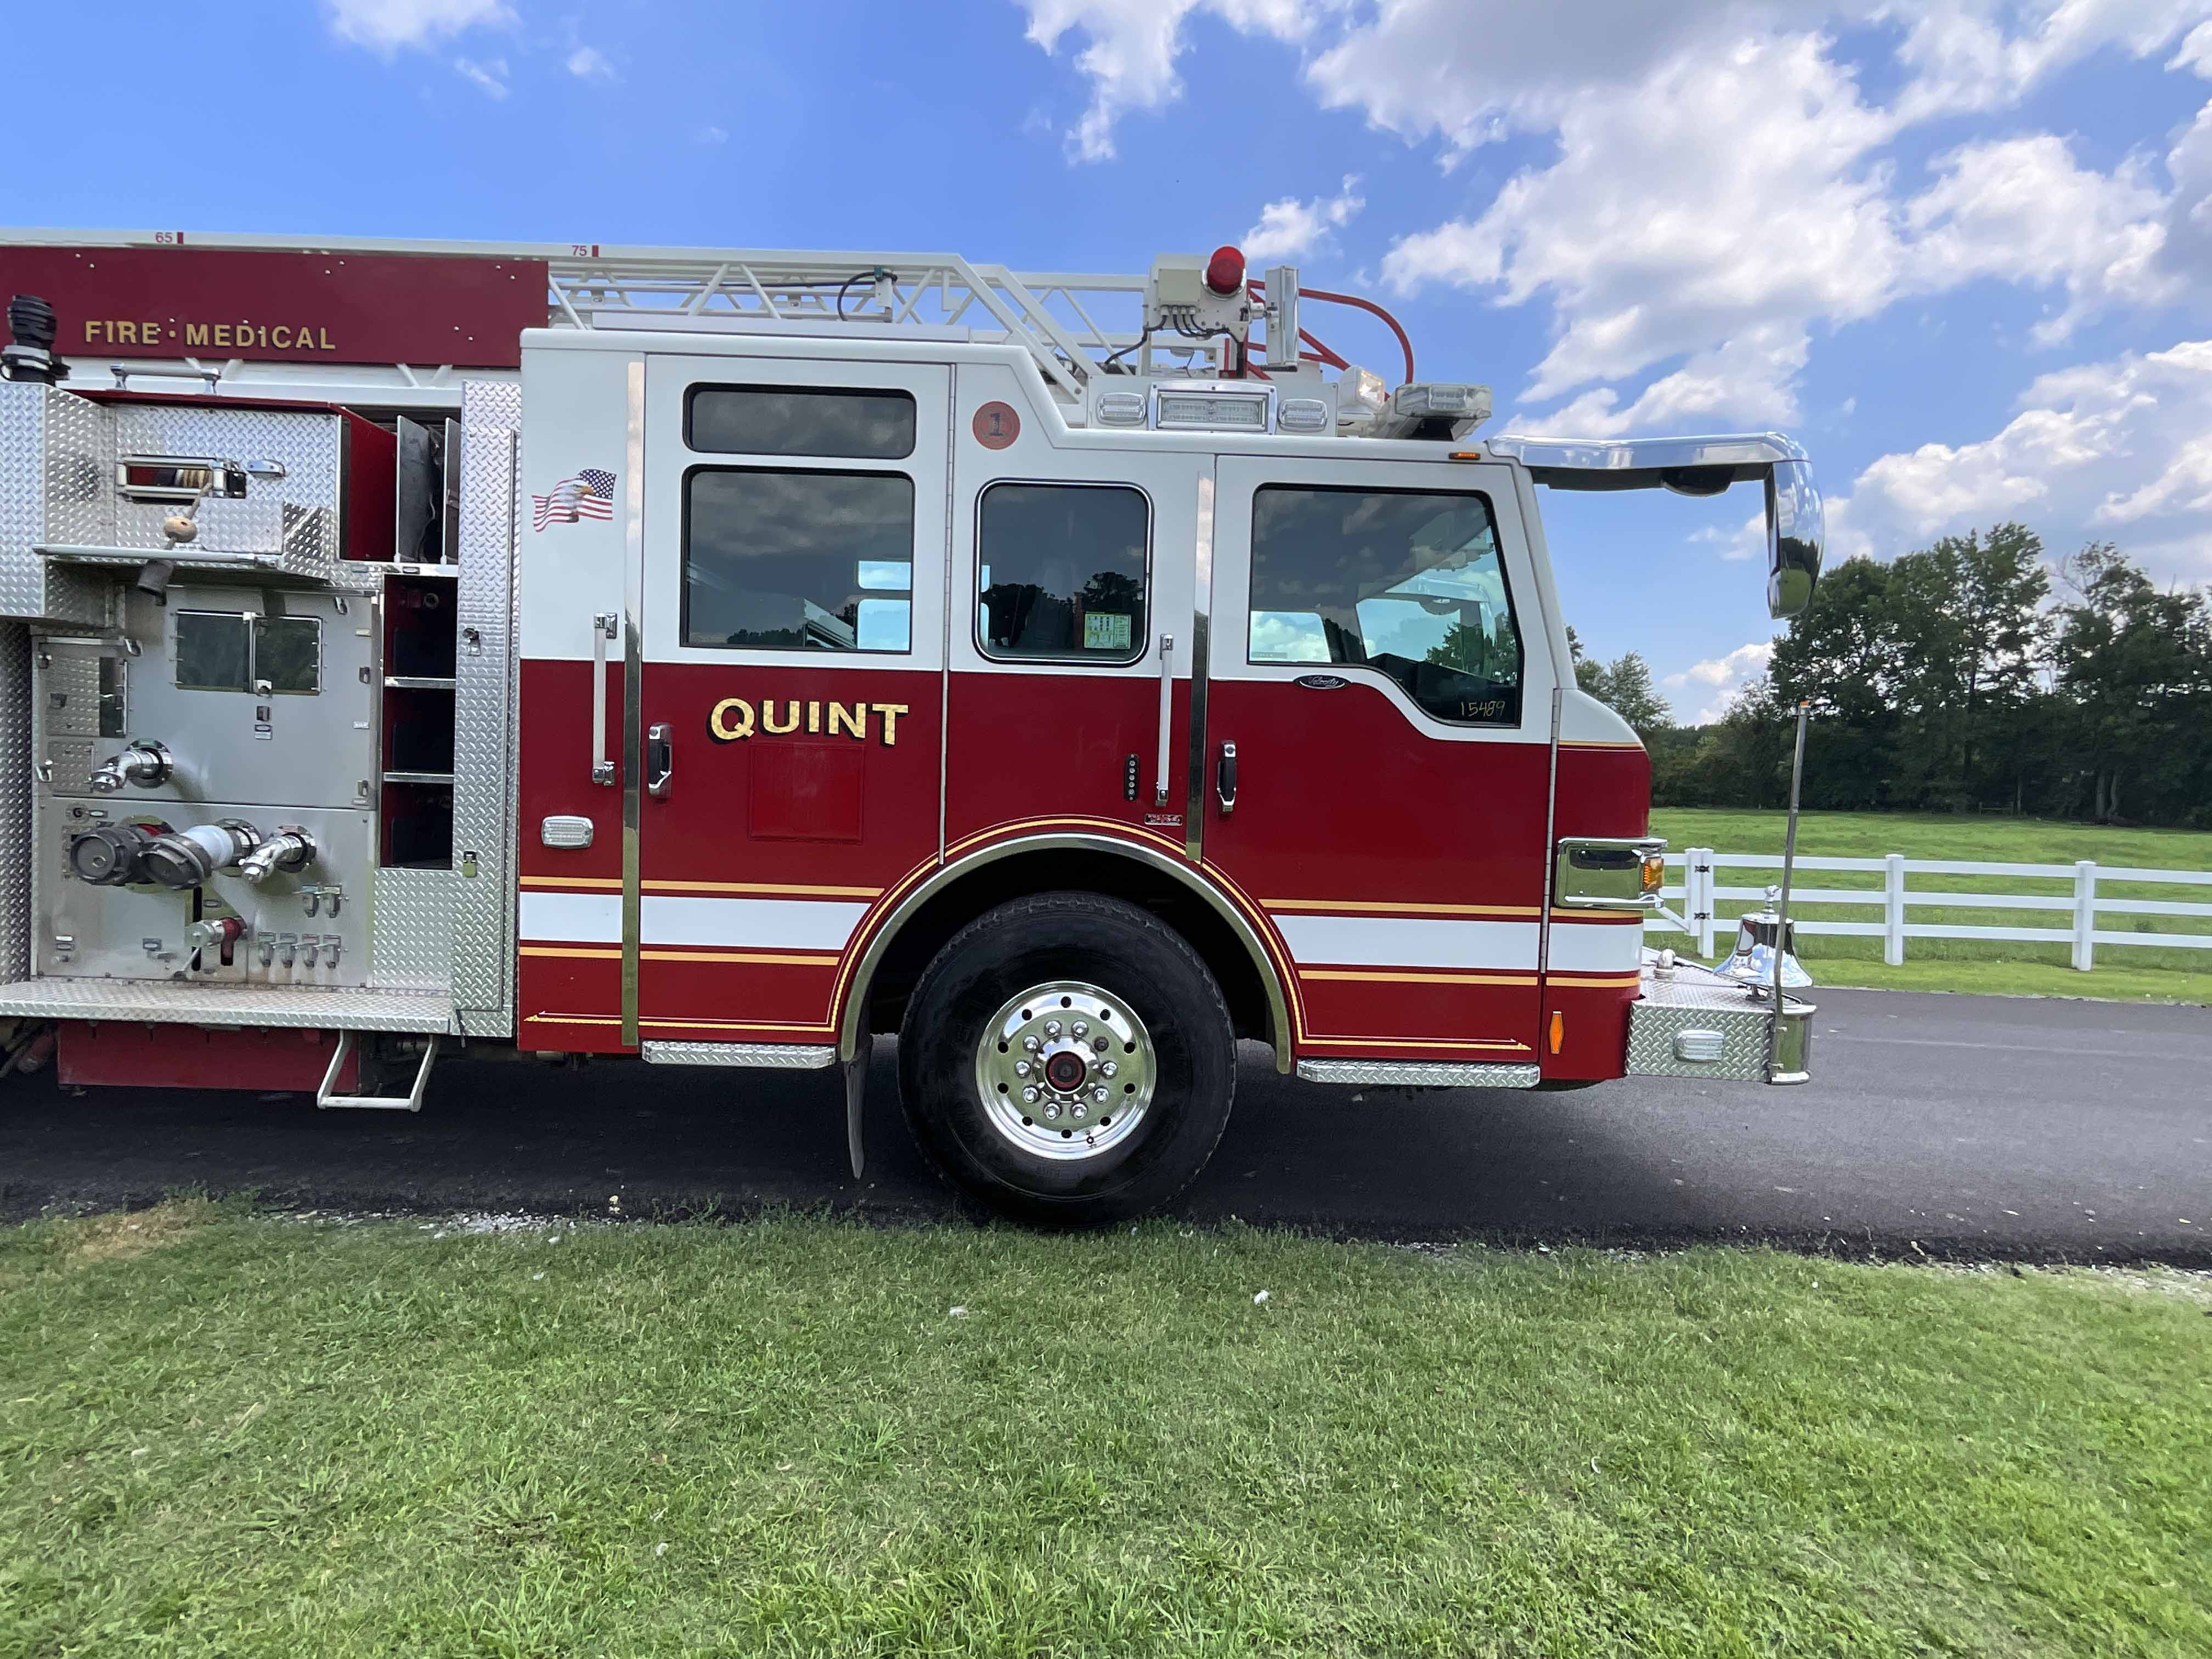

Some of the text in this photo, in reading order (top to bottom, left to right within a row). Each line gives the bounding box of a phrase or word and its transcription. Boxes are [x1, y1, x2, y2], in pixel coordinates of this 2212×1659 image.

[155, 232, 173, 242] 65
[572, 245, 587, 256] 75
[85, 320, 336, 349] FIRE MEDICAL
[1461, 701, 1505, 717] 15489
[709, 697, 909, 746] QUINT
